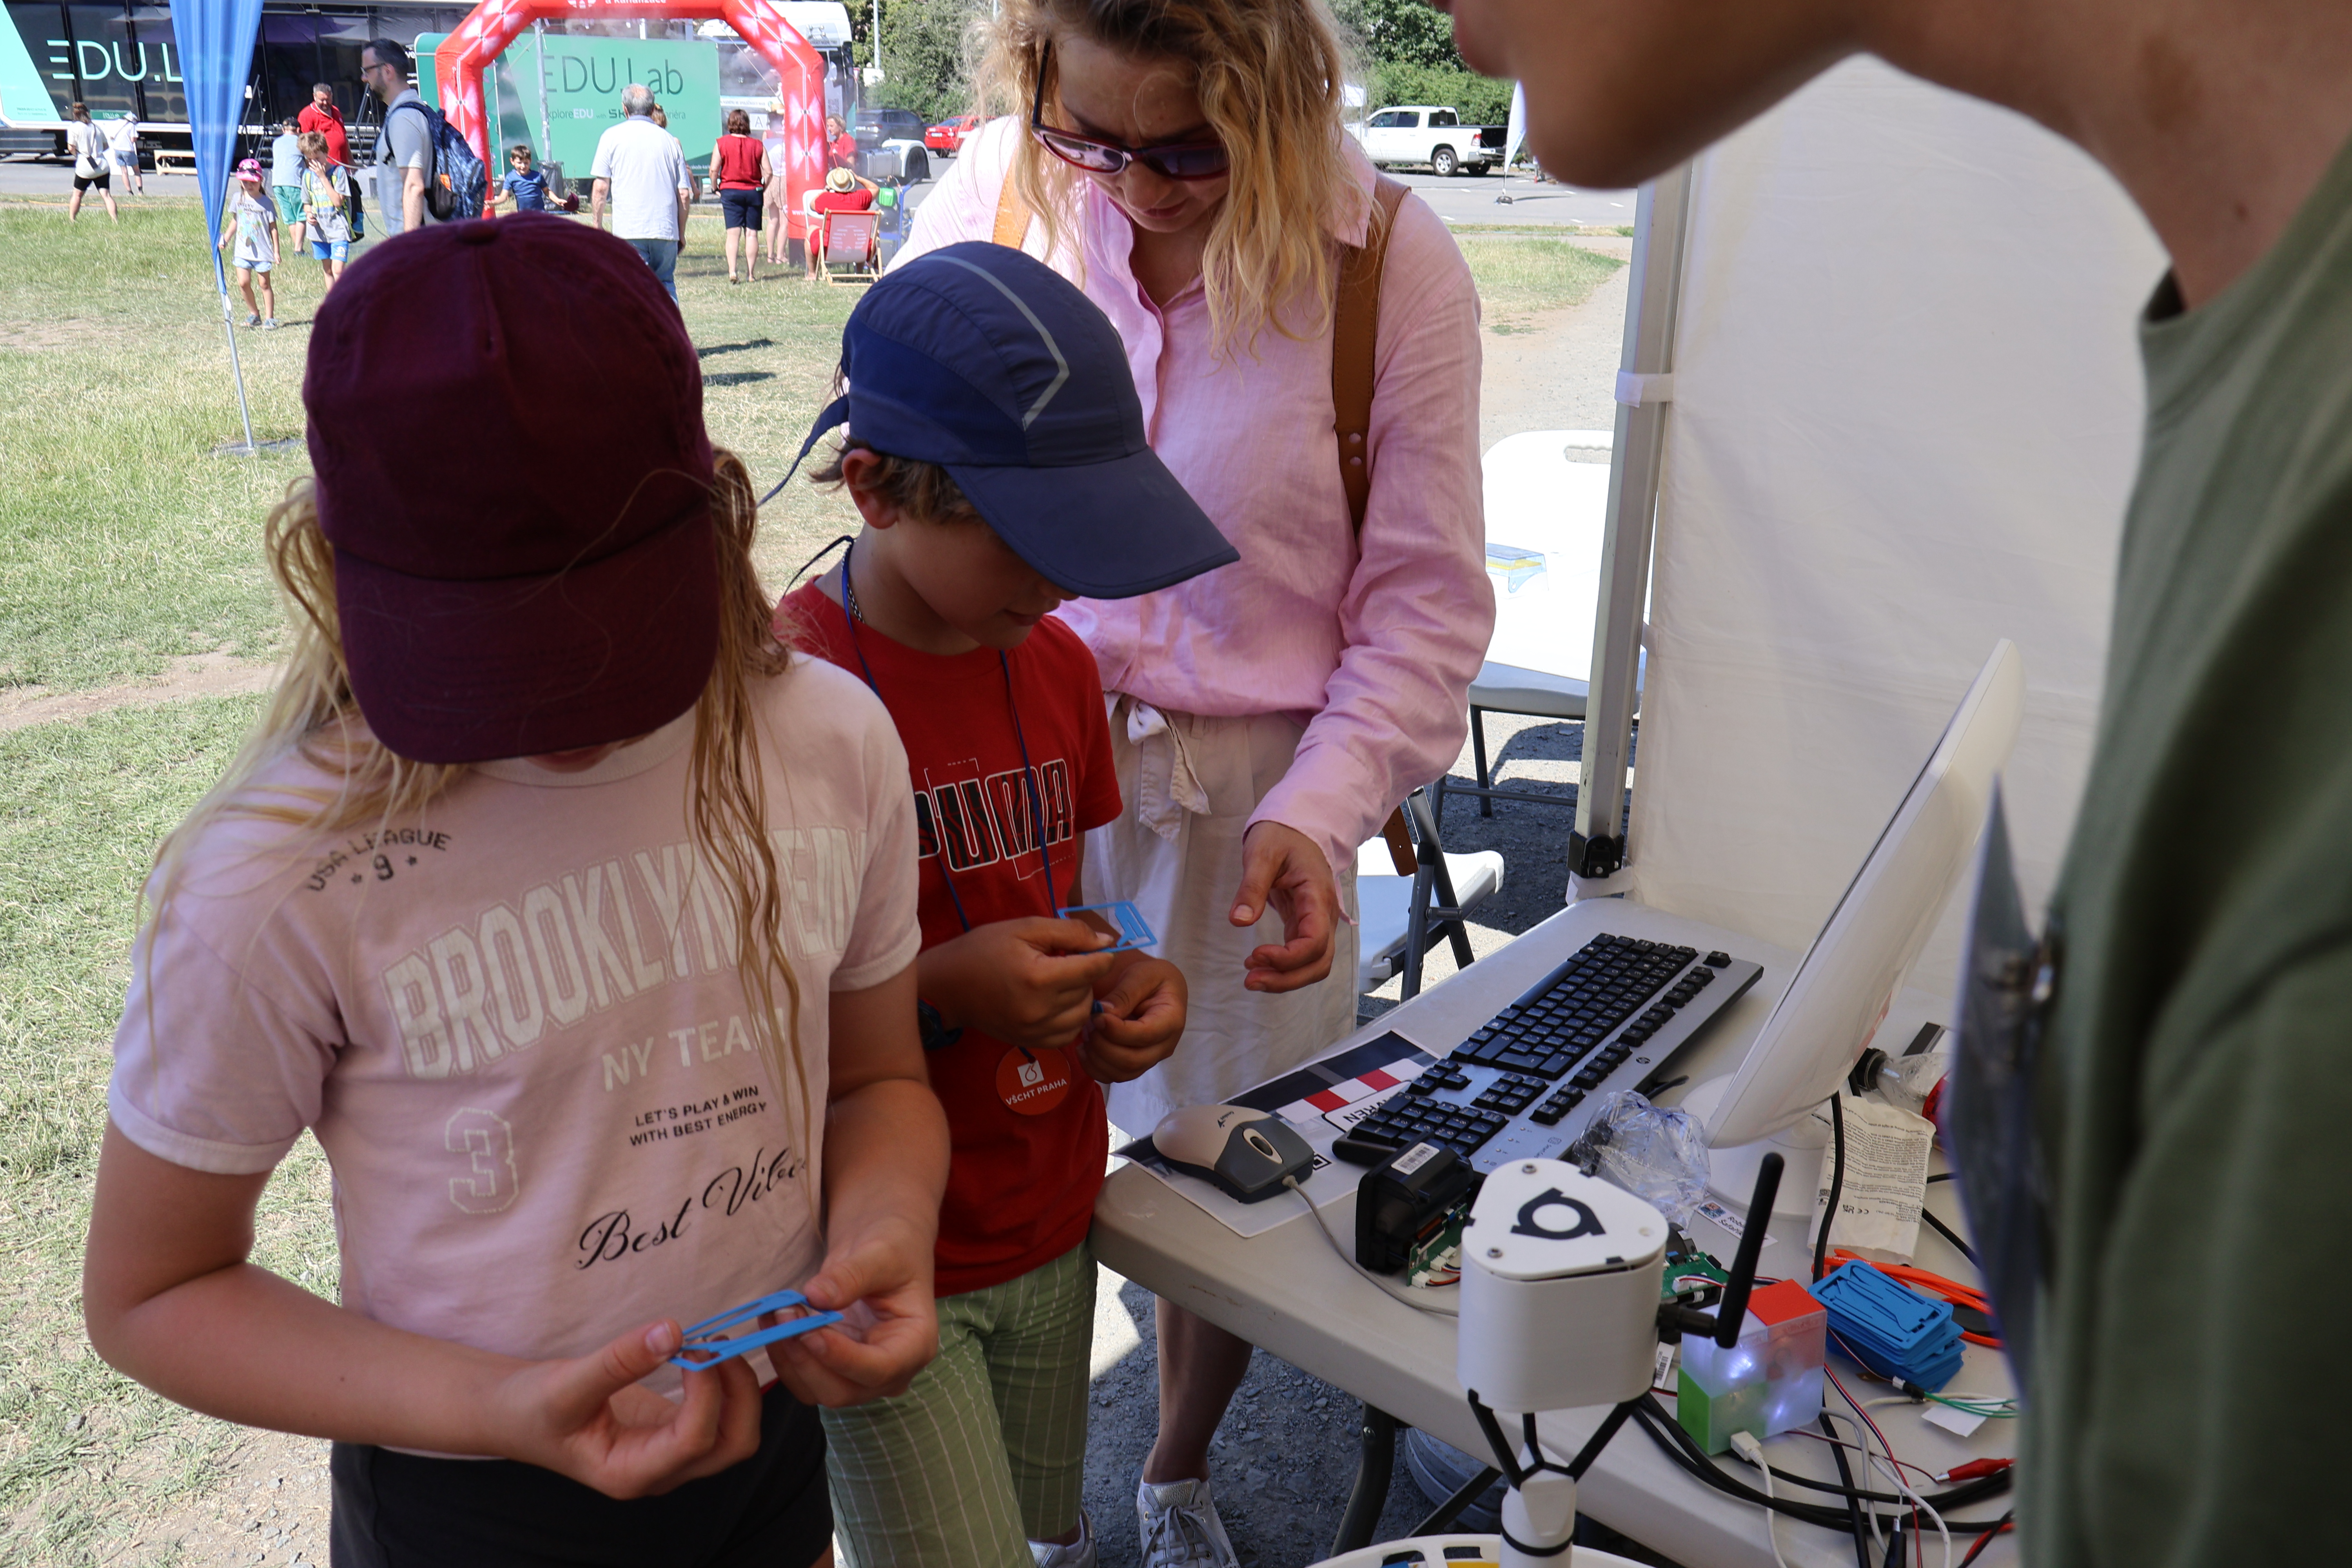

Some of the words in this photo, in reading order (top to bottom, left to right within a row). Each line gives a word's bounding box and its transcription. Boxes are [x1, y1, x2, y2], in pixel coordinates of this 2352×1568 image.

[755, 116, 764, 128] A
[304, 849, 348, 891] USA
[347, 828, 452, 855] LEAGUE
[373, 854, 394, 881] 9
[602, 1036, 654, 1092] NY
[635, 1107, 678, 1127] LET'S
[683, 1096, 719, 1117] PLAY
[722, 1094, 730, 1106] &
[732, 1085, 759, 1102] WIN
[1005, 1089, 1035, 1105] VŠCHT
[1037, 1078, 1067, 1095] PRAHA
[630, 1127, 668, 1147] WITH
[673, 1117, 712, 1138] BEST
[717, 1101, 767, 1126] ENERGY
[445, 1107, 519, 1214] 3
[575, 1209, 692, 1270] Best
